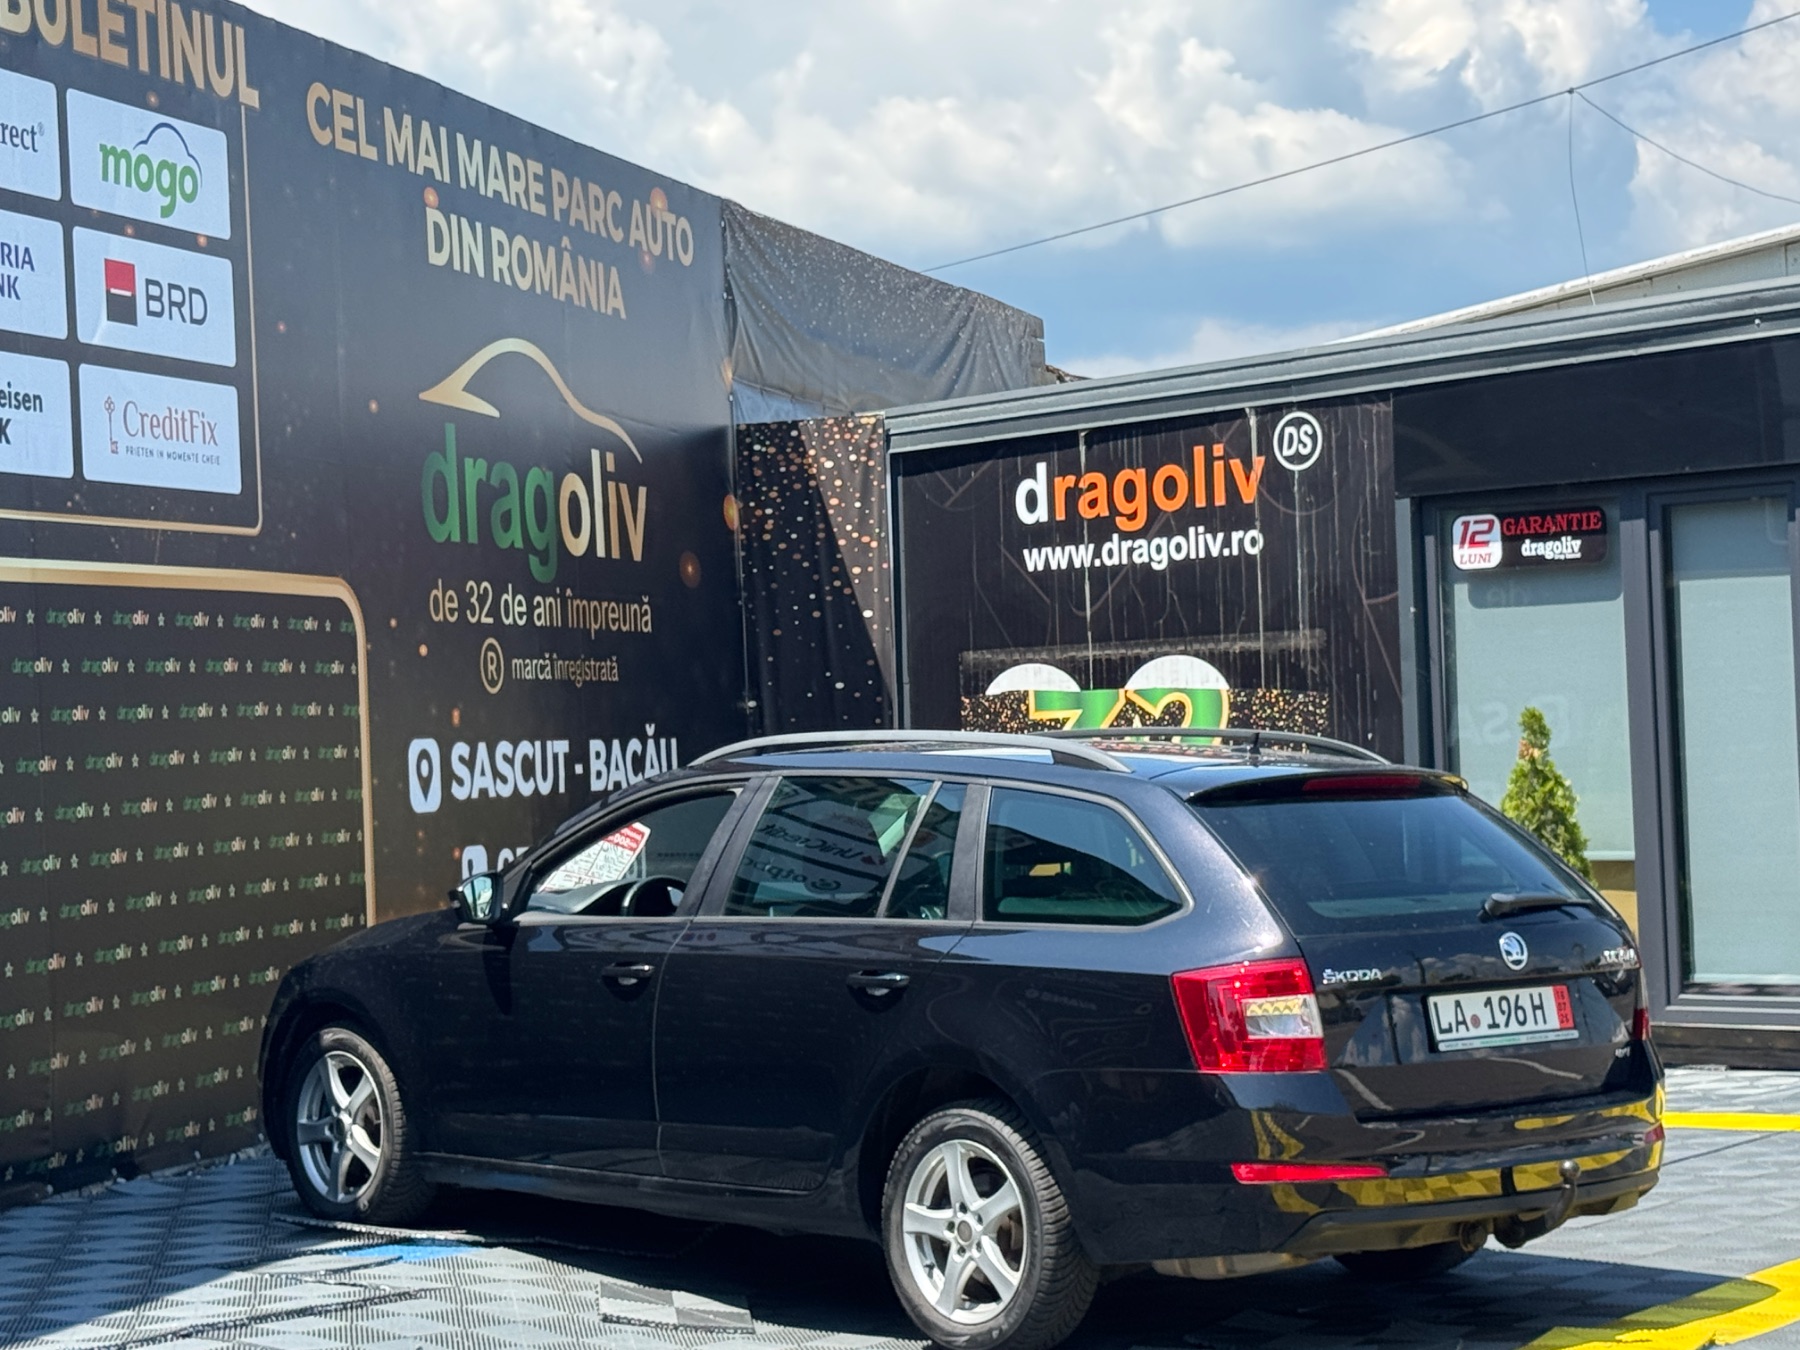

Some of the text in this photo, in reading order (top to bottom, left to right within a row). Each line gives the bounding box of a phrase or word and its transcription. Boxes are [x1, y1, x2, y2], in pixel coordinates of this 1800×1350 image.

[99, 143, 199, 219] mogo
[307, 82, 694, 267] CEL MAI MARE PARC AUTO
[426, 206, 627, 321] DIN ROMÂNIA
[145, 278, 208, 326] BRD
[0, 381, 43, 413] eisen
[123, 400, 218, 447] CreditFix
[1282, 423, 1313, 457] DS
[126, 445, 154, 458] PRIETEN
[166, 451, 199, 464] MOMENTE
[202, 454, 220, 466] CHEIE
[421, 423, 647, 583] dragoliv
[1015, 444, 1266, 532] dragoliv
[1459, 518, 1495, 549] 12
[1502, 511, 1602, 536] GARANTIE
[1023, 524, 1265, 572] www.dragoliv.ro
[1459, 553, 1492, 565] LUNI
[1521, 535, 1582, 560] dragoliv
[430, 578, 652, 640] de 32 de ani împreună
[512, 652, 552, 680] marcă
[552, 652, 619, 688] înregistrată
[451, 739, 570, 801] SASCUT
[588, 723, 678, 793] BACĂU
[1322, 968, 1383, 985] ŠKODA
[1433, 999, 1470, 1034] LA
